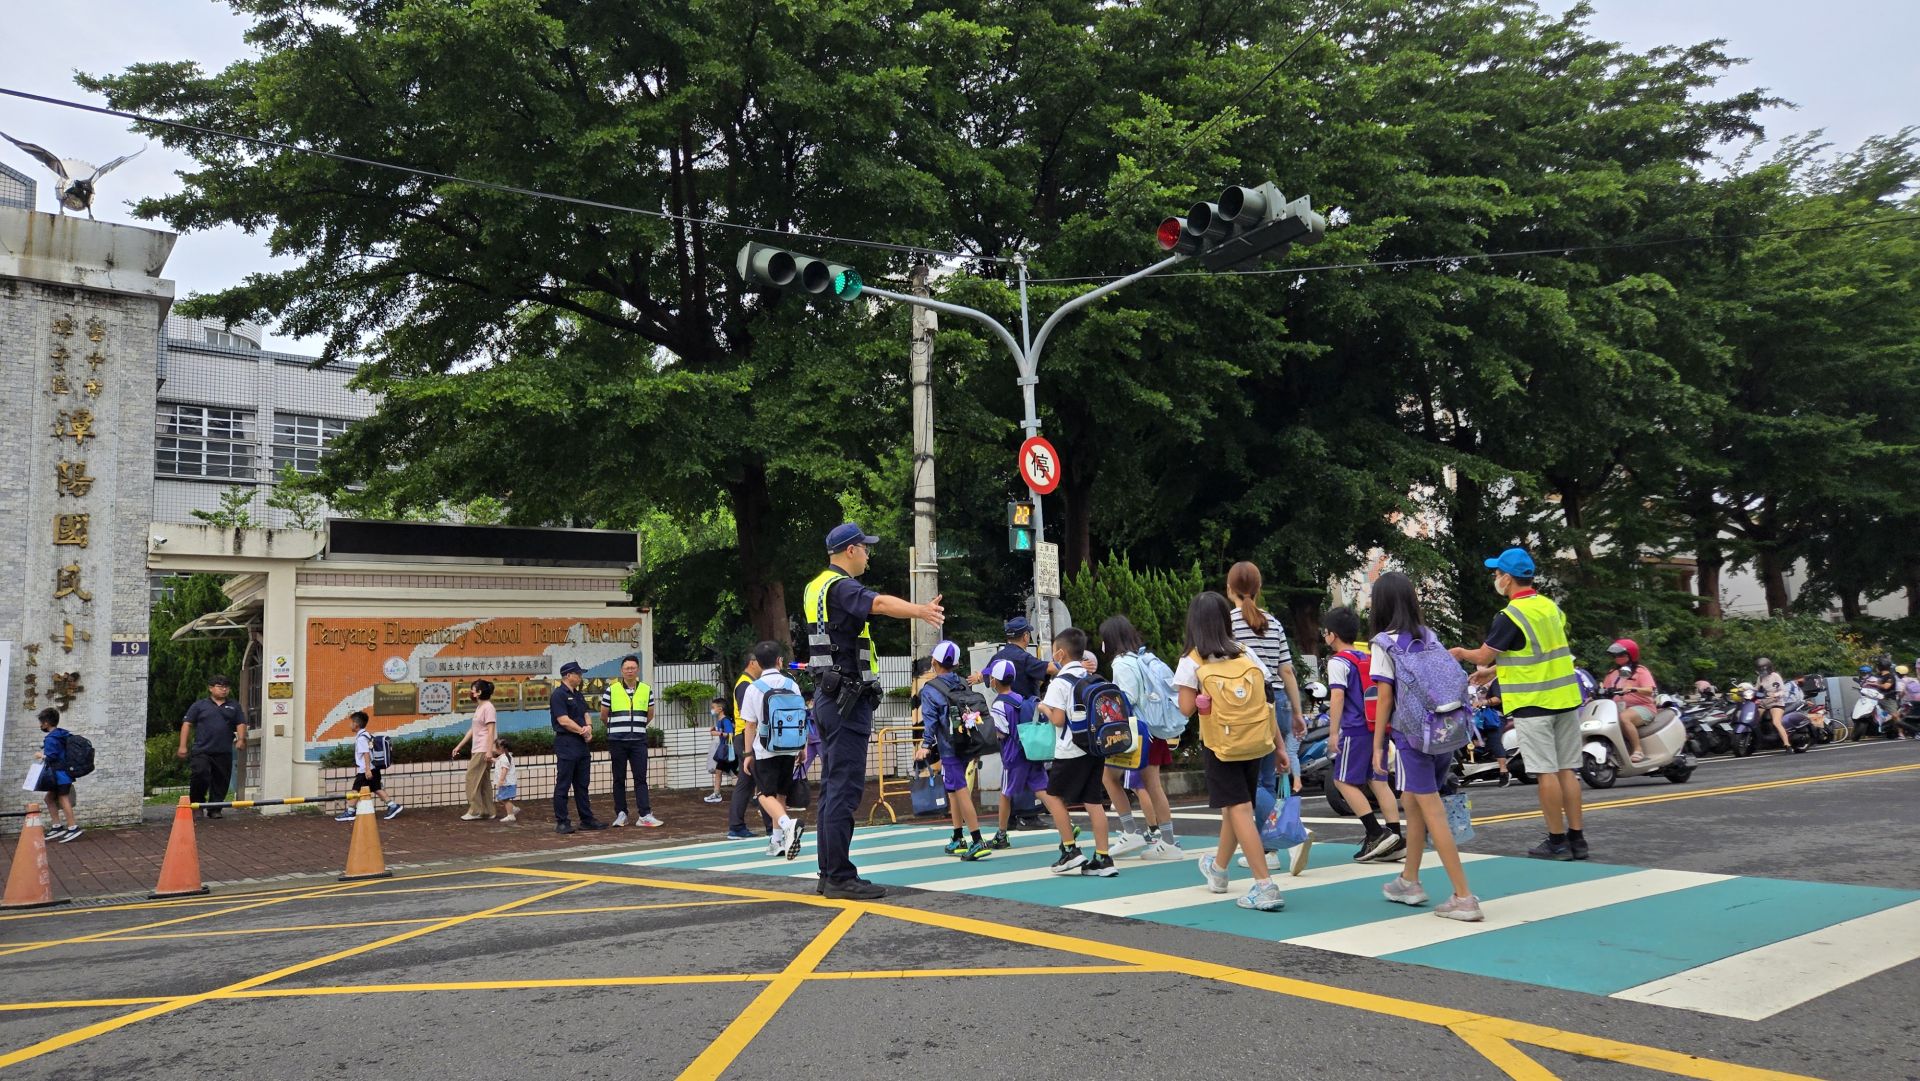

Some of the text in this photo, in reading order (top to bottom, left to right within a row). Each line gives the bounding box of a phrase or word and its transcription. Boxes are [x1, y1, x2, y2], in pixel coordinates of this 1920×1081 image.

[1031, 453, 1049, 478] 停
[1014, 505, 1030, 525] 22
[47, 408, 95, 712] 潭陽國民小學
[311, 621, 640, 650] Tanyang Elementary School Tantz, Taichung
[121, 642, 140, 655] 19
